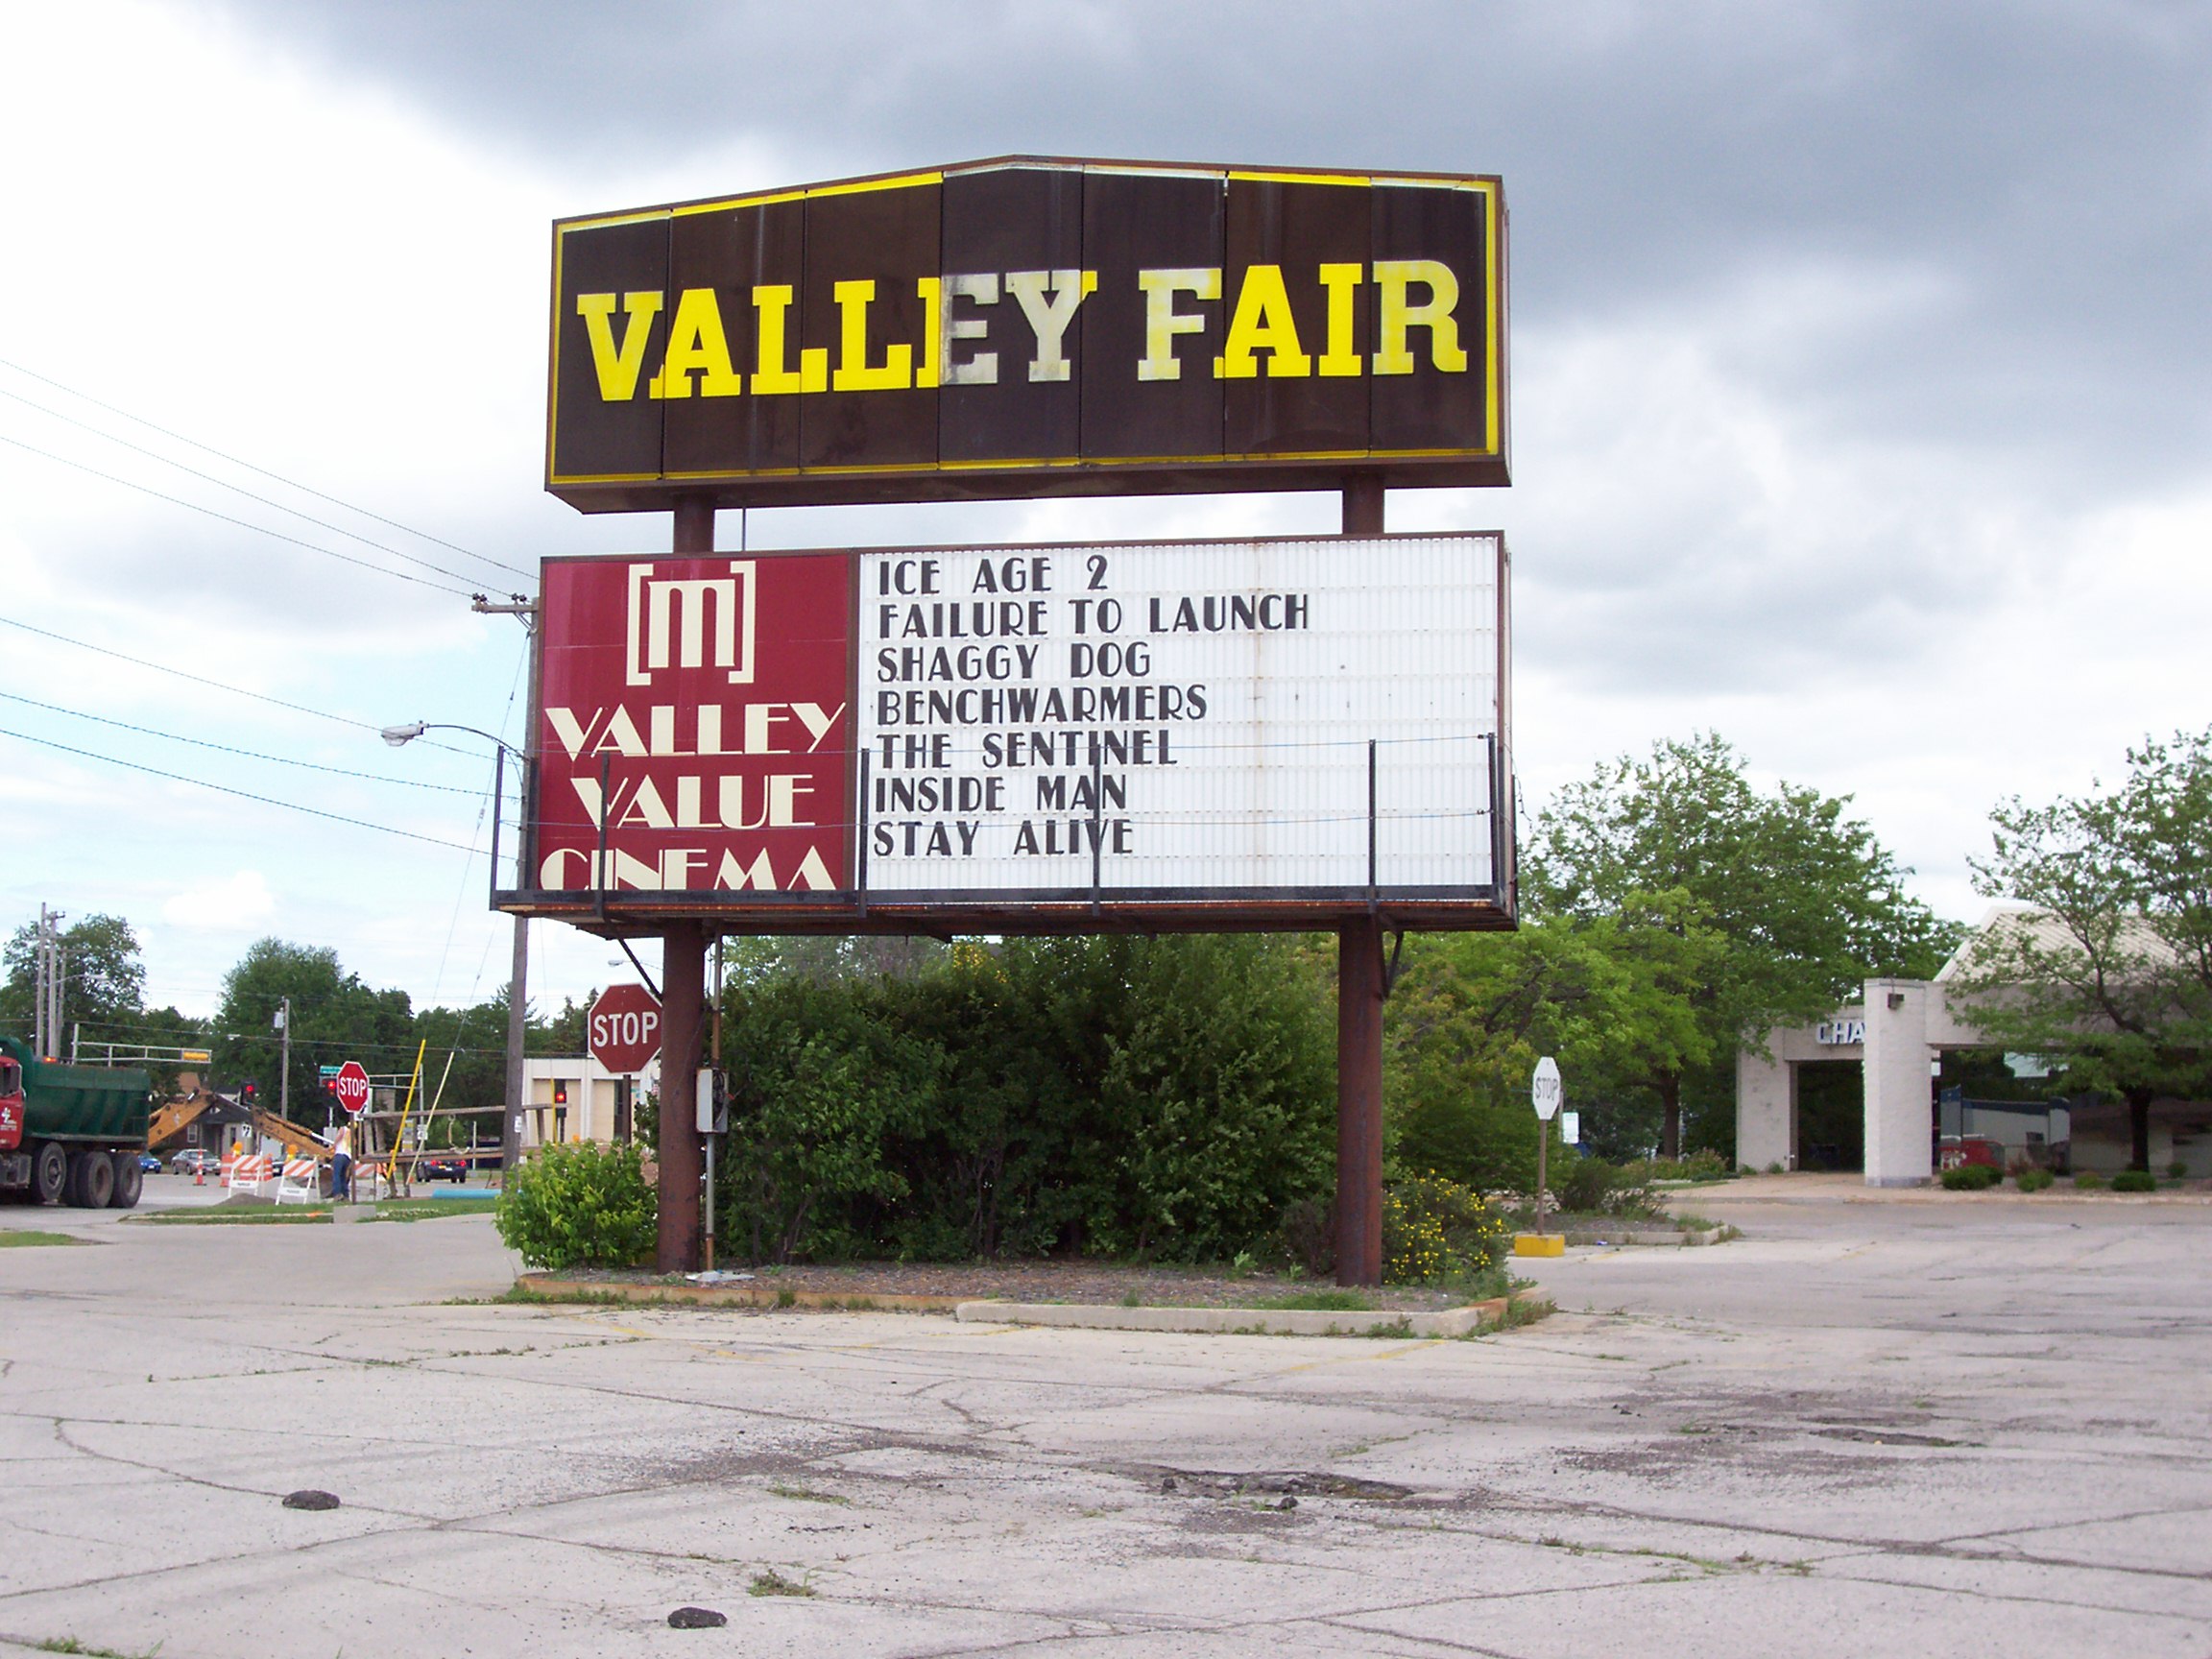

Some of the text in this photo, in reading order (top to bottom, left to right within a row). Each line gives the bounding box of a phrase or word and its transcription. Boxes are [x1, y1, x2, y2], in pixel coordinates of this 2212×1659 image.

[577, 261, 1468, 401] VALLEY FAIR
[878, 555, 1108, 594] ICE AGE 2
[879, 594, 1308, 638] FAILURE TO LAUNCH
[878, 641, 1150, 682] SHAGGY DOG
[878, 685, 1207, 726] BENCHWARMERS
[545, 702, 846, 761] VALLEY
[877, 729, 1177, 769] THE SENTINEL
[570, 775, 815, 831] VALUE
[875, 773, 1127, 812] INSIDE MAN
[873, 819, 1133, 857] STAY ALIVE
[541, 845, 837, 890] CINEMA
[593, 1011, 659, 1047] STOP
[339, 1076, 367, 1097] STOP
[1536, 1076, 1558, 1101] STOP
